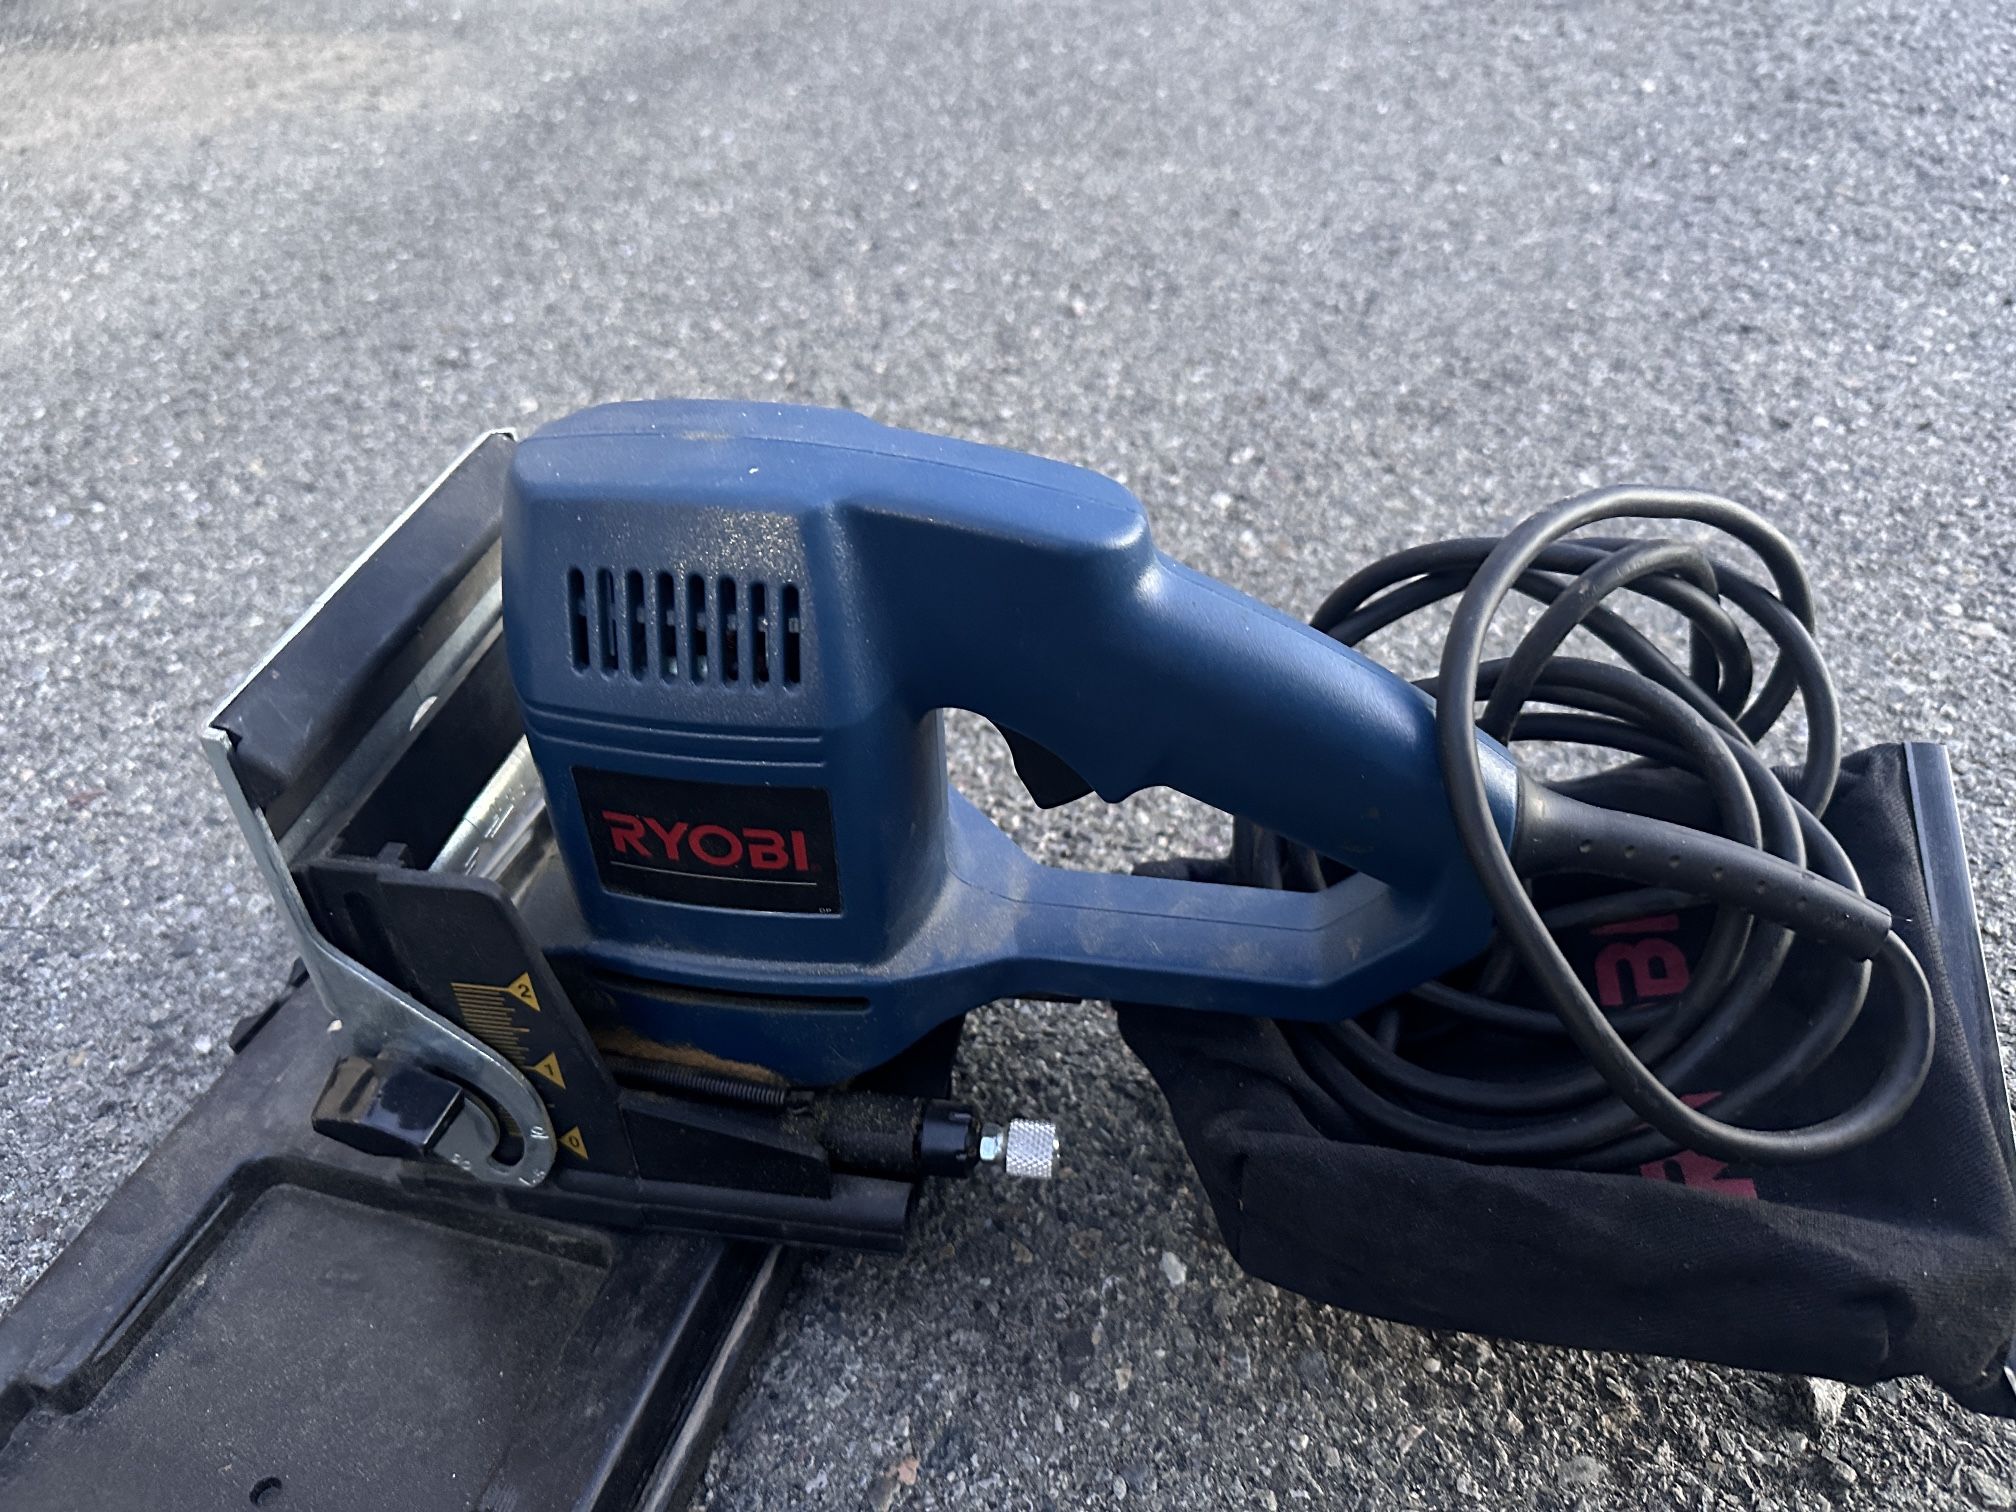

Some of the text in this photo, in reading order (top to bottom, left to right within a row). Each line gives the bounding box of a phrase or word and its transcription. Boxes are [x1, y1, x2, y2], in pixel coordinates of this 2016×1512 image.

[602, 811, 810, 872] RYOBI
[518, 984, 532, 998] 2
[544, 1063, 555, 1077] 1
[568, 1135, 580, 1148] 0
